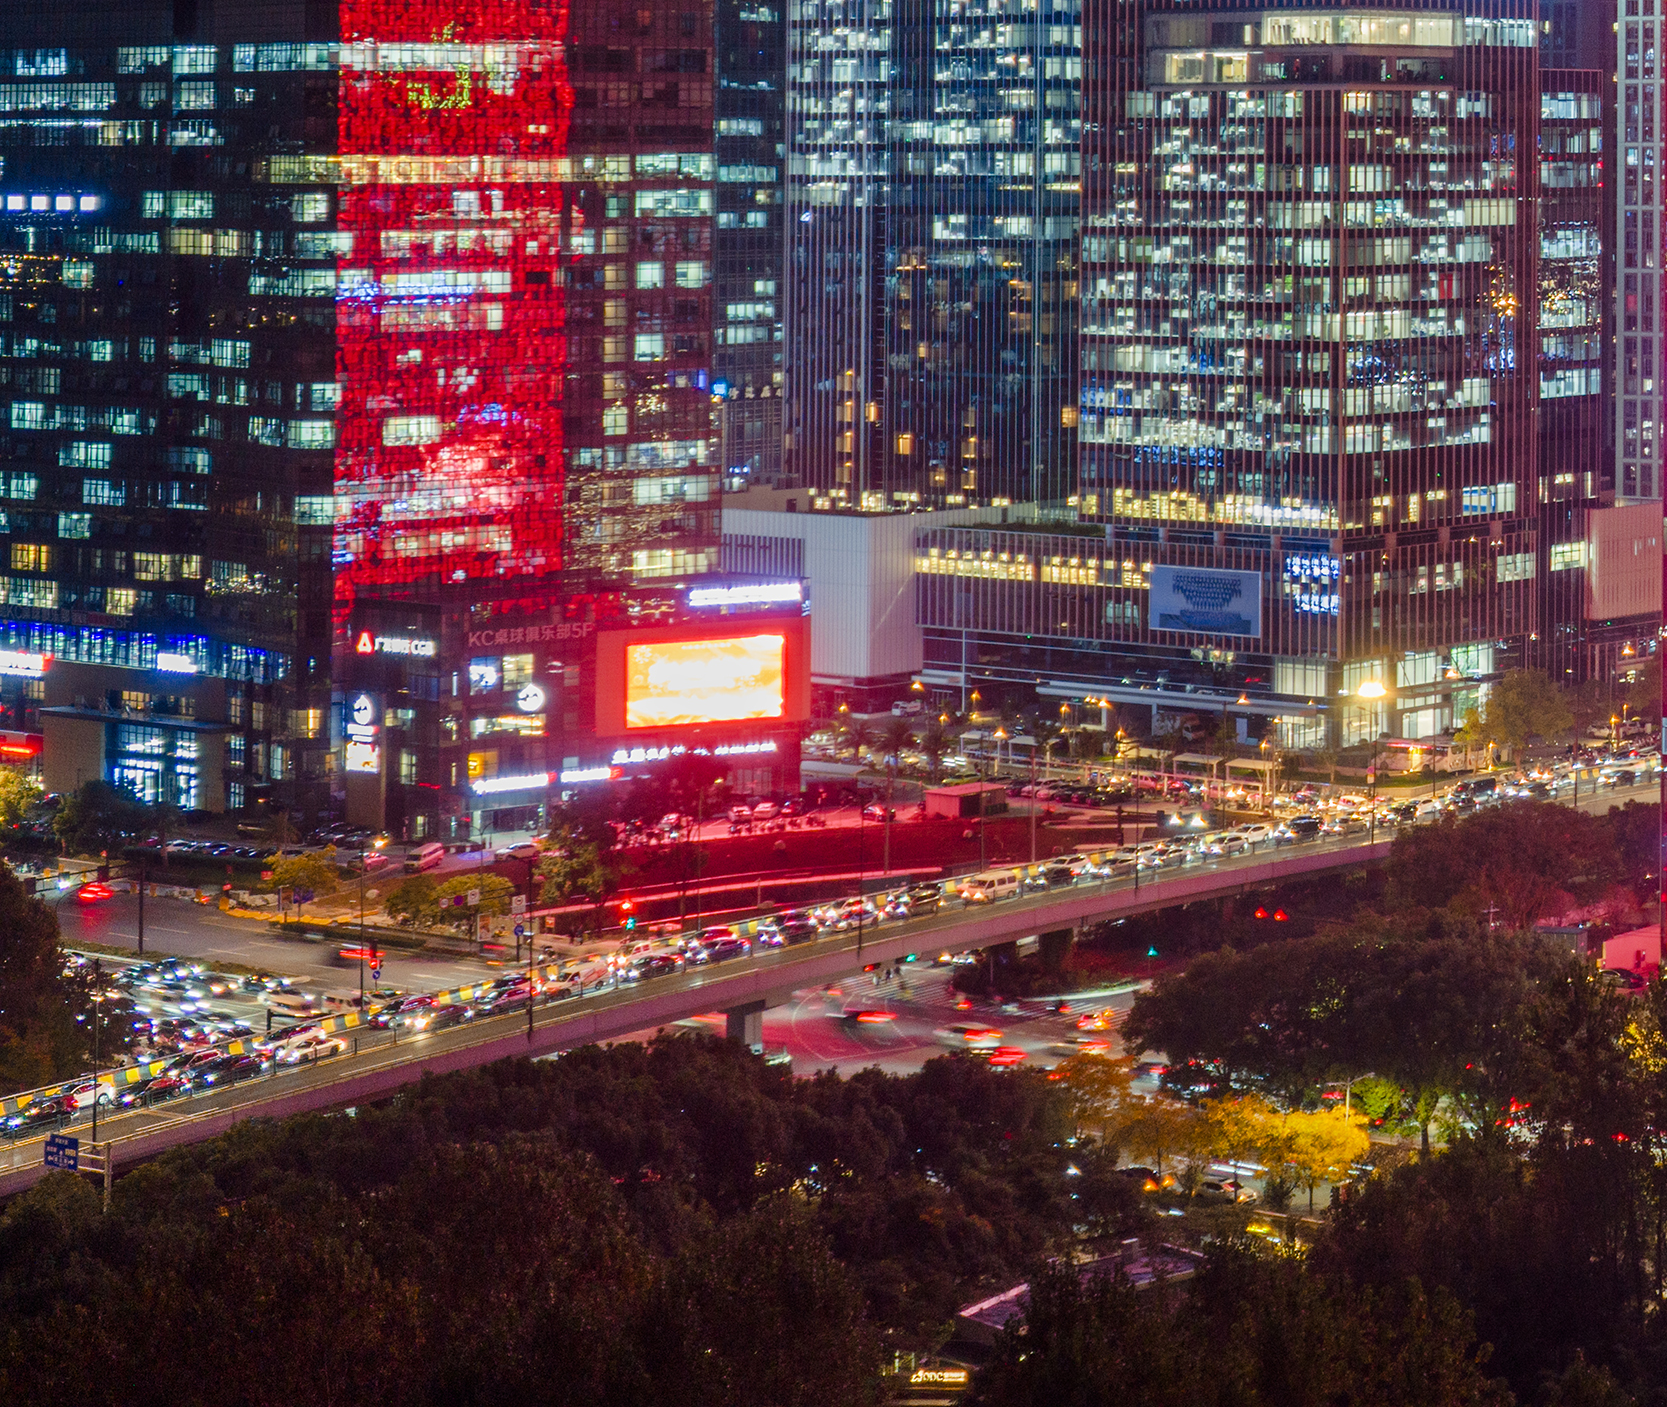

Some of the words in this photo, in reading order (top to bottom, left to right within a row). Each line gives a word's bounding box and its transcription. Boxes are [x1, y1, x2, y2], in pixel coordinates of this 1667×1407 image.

[468, 622, 594, 647] KC桌球俱乐部5F
